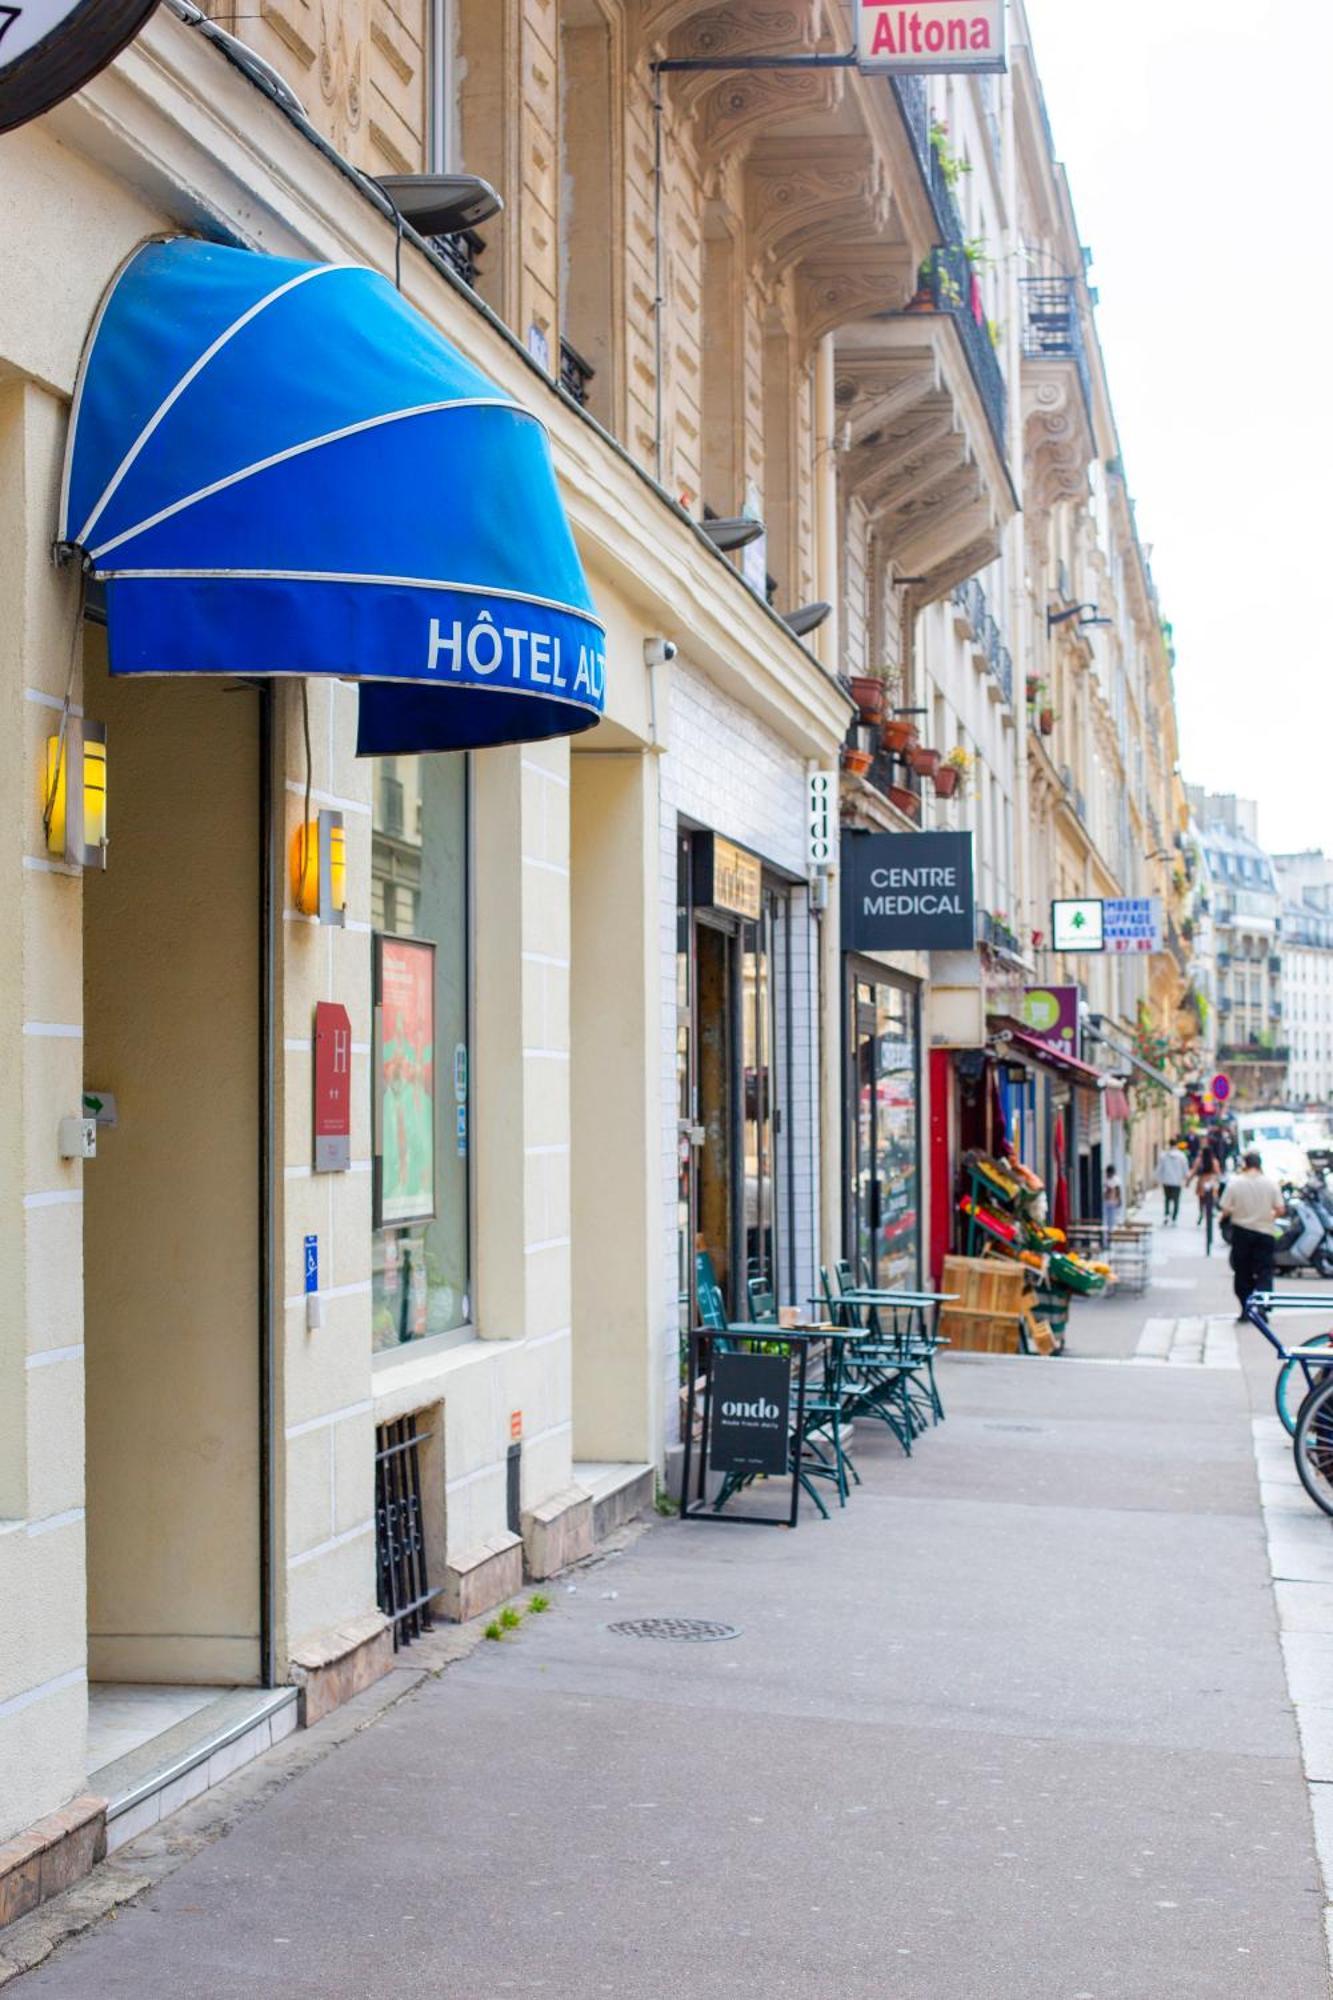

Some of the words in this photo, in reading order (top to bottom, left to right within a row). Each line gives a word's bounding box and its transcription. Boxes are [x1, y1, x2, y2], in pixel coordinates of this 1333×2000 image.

[870, 11, 990, 55] Altona
[427, 610, 567, 687] HÔTEL
[811, 776, 828, 858] ondo
[870, 867, 956, 888] CENTRE
[863, 895, 965, 915] MEDICAL
[333, 1029, 347, 1073] H
[721, 1397, 780, 1419] ondo
